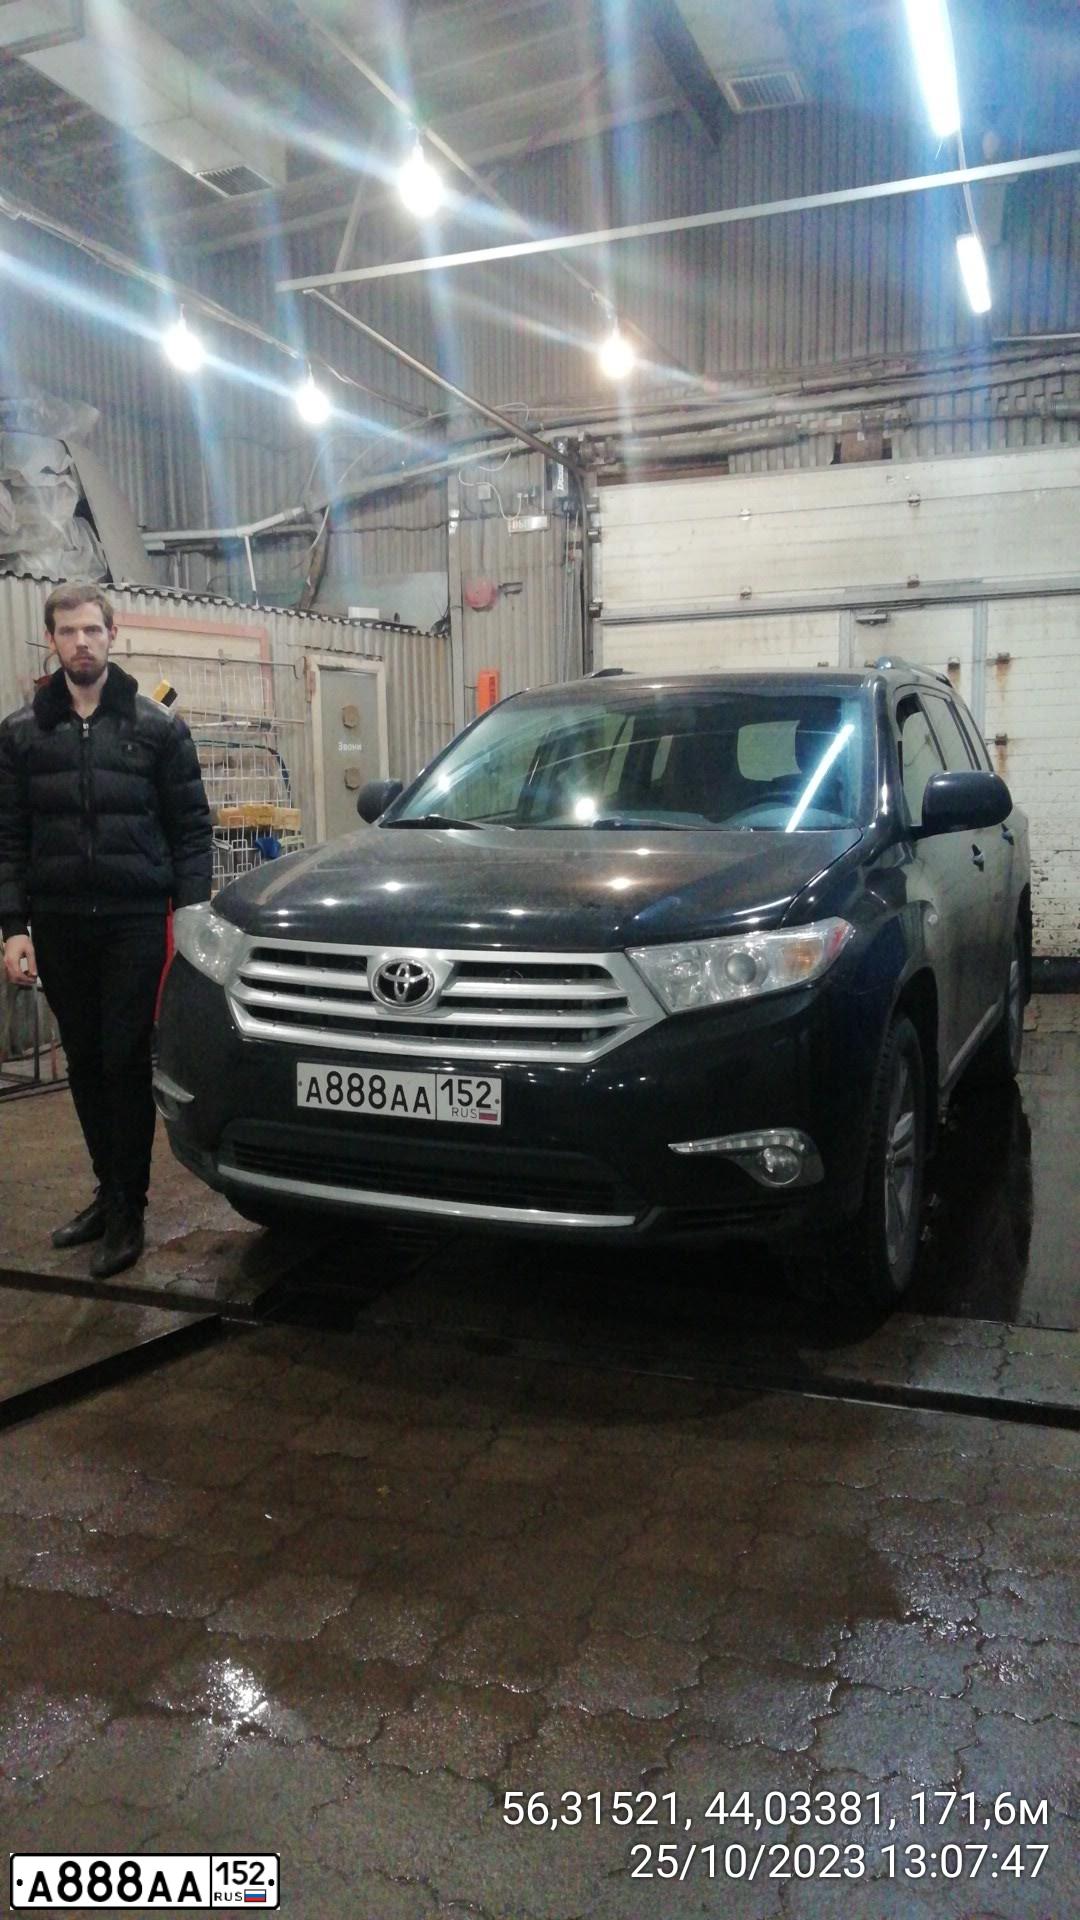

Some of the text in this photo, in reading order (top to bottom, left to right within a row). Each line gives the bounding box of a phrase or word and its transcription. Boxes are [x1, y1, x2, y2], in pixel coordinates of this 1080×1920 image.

[306, 1071, 492, 1114] А888АА 152
[451, 1107, 477, 1119] RUS
